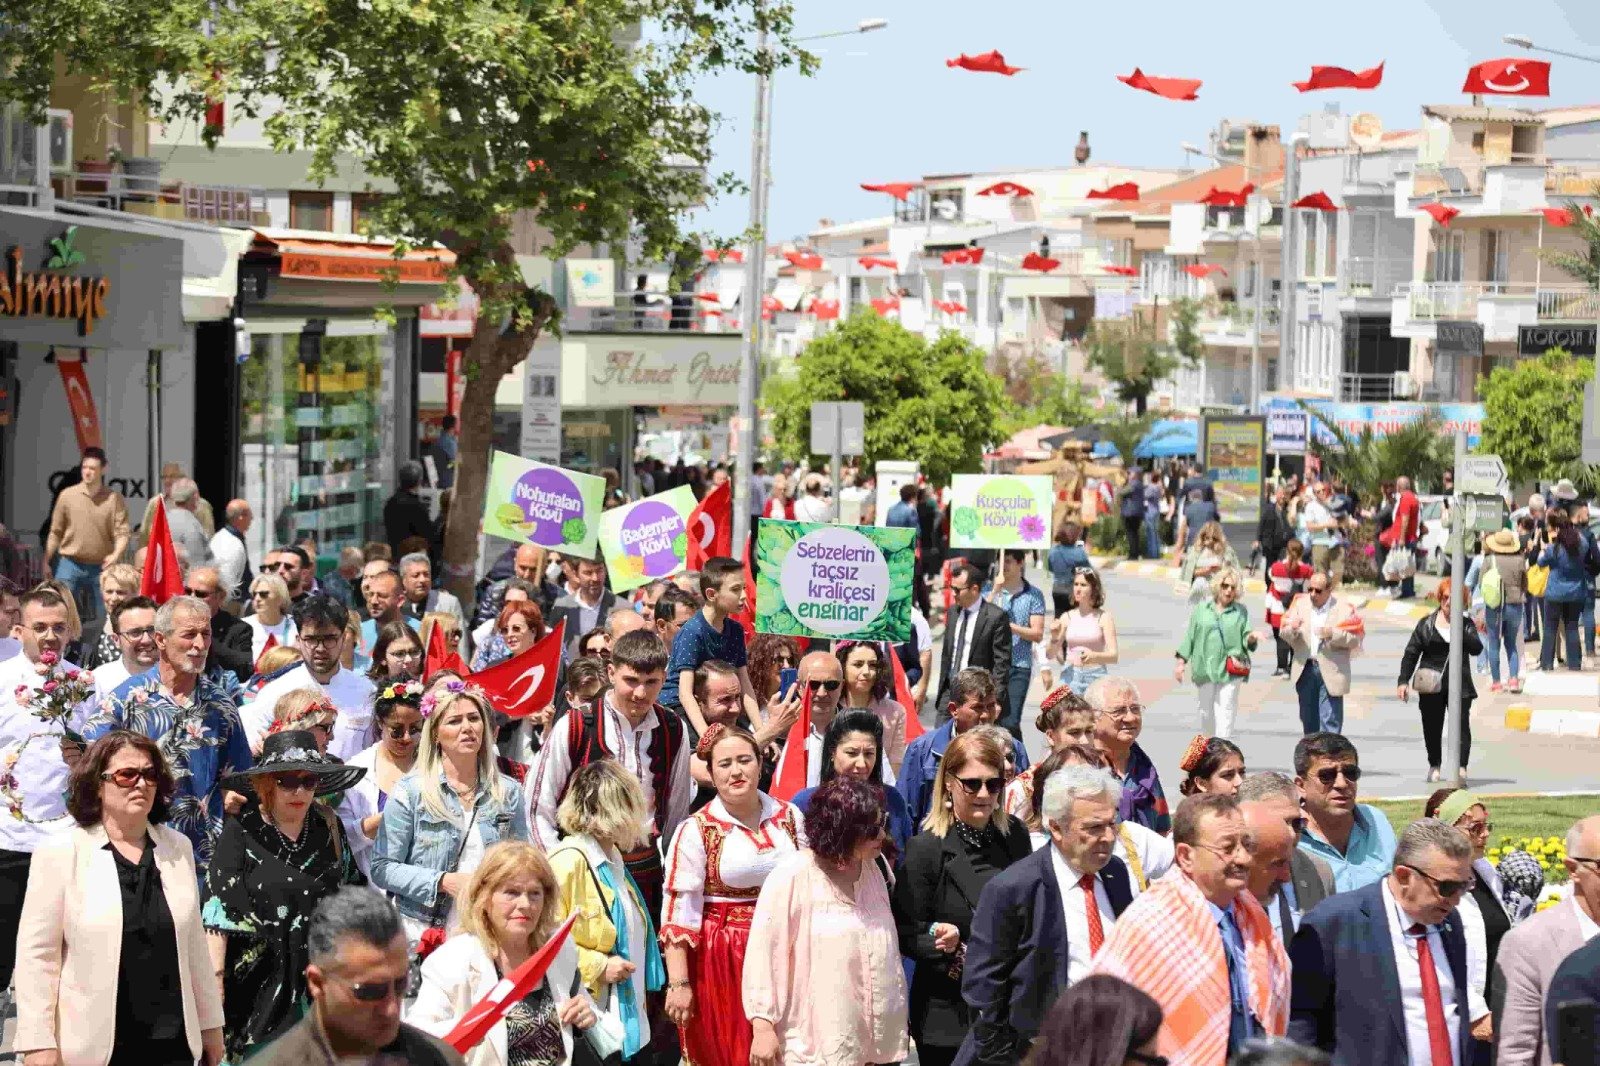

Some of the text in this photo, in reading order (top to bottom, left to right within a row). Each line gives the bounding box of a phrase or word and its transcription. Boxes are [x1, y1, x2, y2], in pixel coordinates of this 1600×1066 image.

[592, 350, 678, 384] Ahmet
[516, 482, 581, 512] Nohutalan
[529, 501, 563, 524] Köyü
[983, 511, 1018, 528] Köyü
[622, 515, 680, 545] Bademler
[638, 532, 672, 557] Köyü
[796, 541, 875, 563] Sebzelerin
[811, 561, 859, 582] taçsız
[808, 581, 876, 602] kraliçesi
[798, 601, 869, 622] enginar
